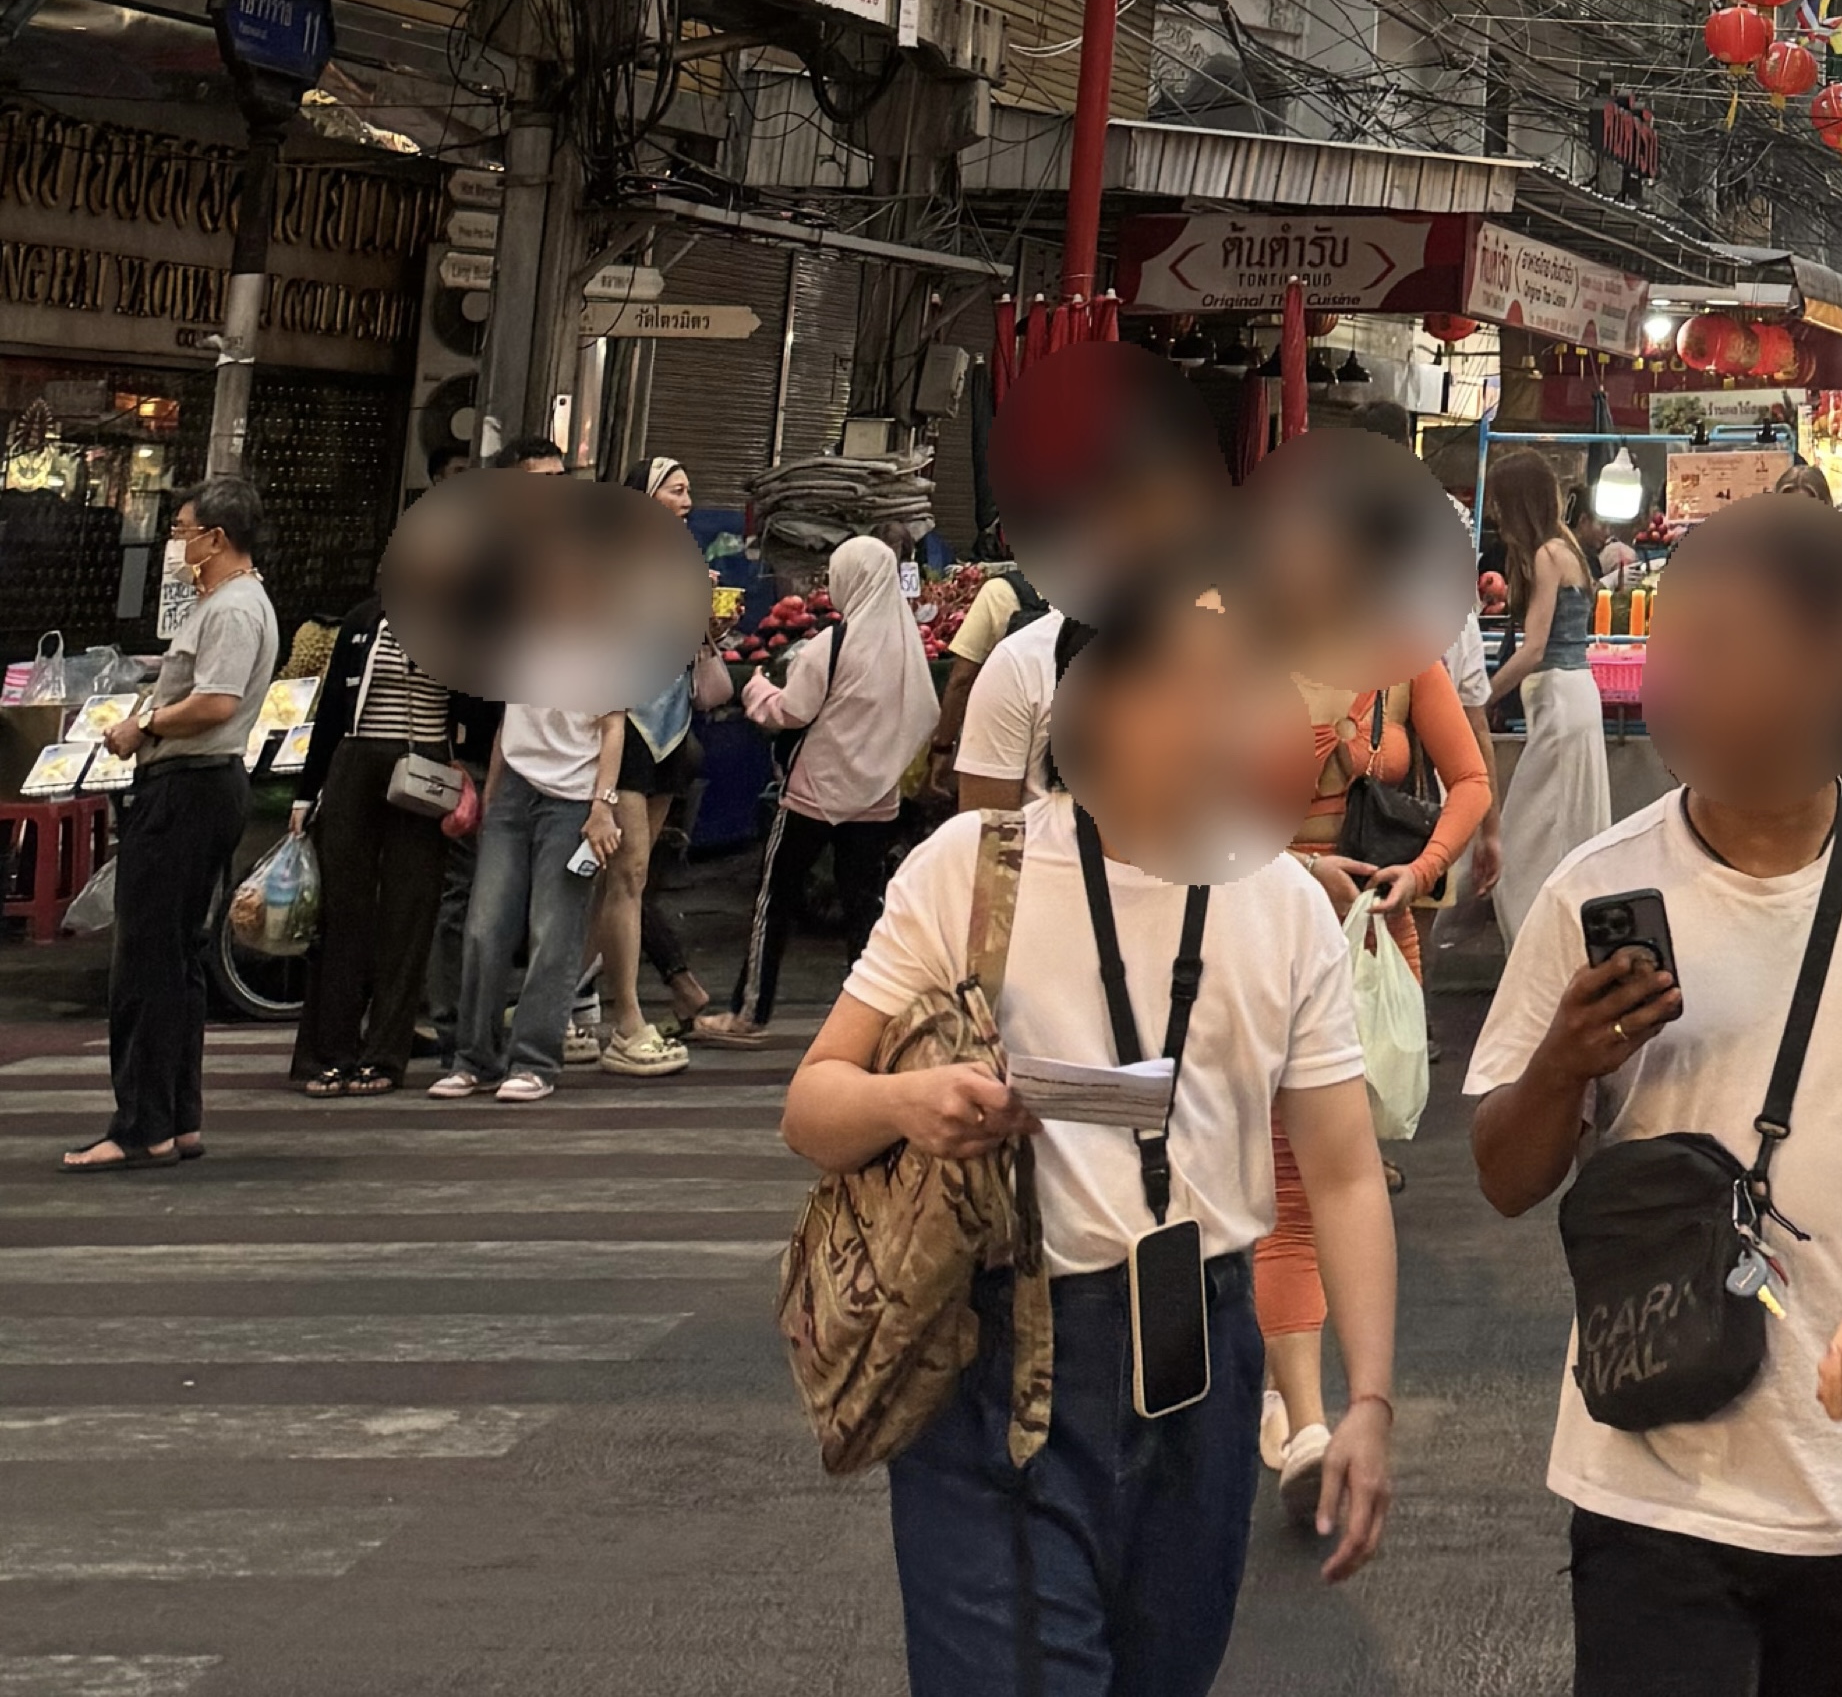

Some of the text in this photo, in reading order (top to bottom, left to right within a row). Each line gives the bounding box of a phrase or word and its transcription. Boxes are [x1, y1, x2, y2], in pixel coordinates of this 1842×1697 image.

[1221, 221, 1350, 269] ต้นตำรับ
[1202, 293, 1264, 309] Original
[1306, 292, 1361, 307] Cuisine
[634, 305, 710, 330] วัดไตรมิตร
